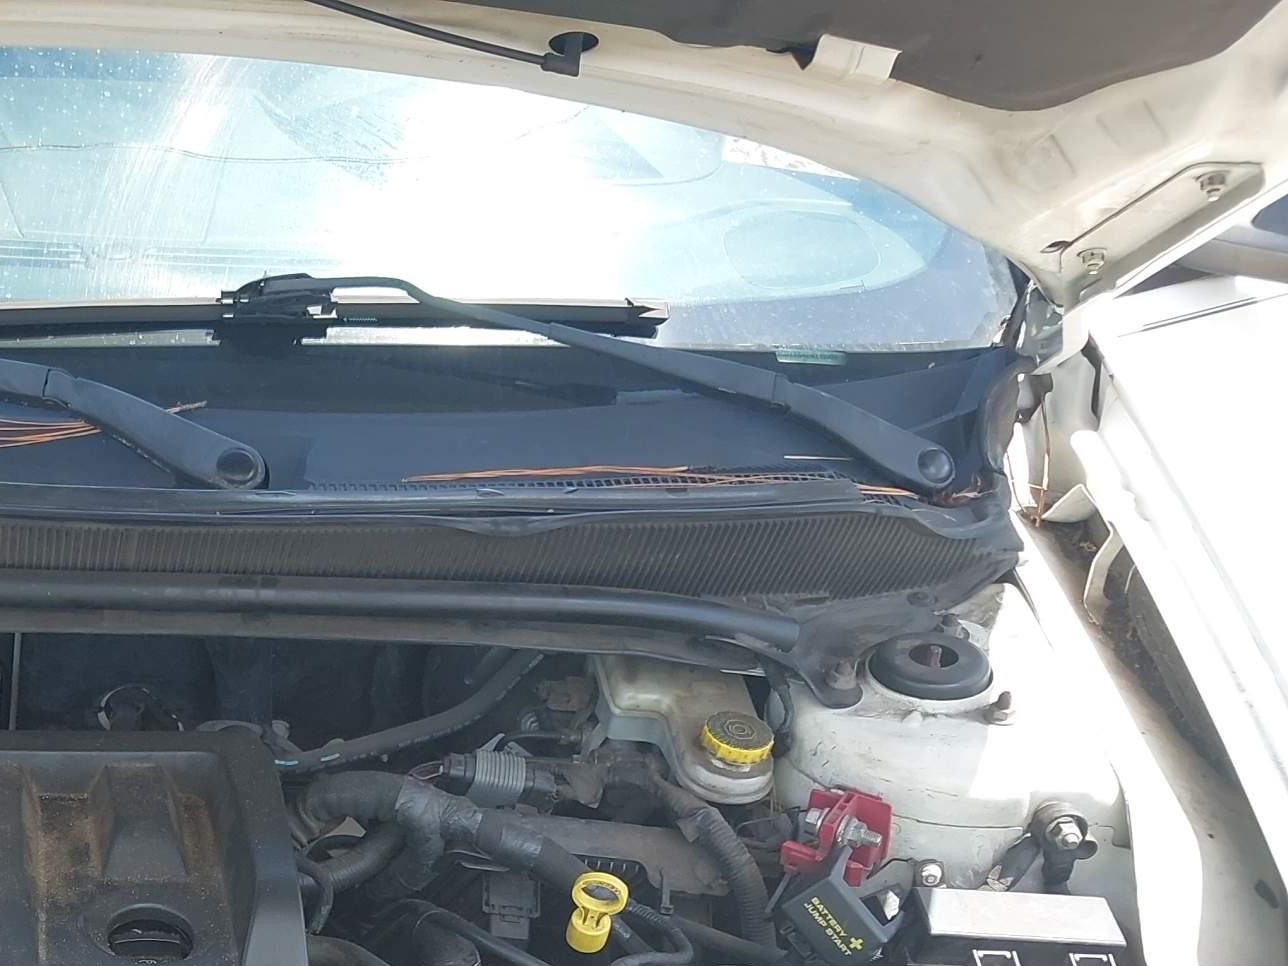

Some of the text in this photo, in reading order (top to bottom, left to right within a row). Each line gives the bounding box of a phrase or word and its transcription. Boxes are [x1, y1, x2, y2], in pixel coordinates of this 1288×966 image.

[803, 902, 853, 957] JUMP START
[811, 896, 848, 937] BATTERY
